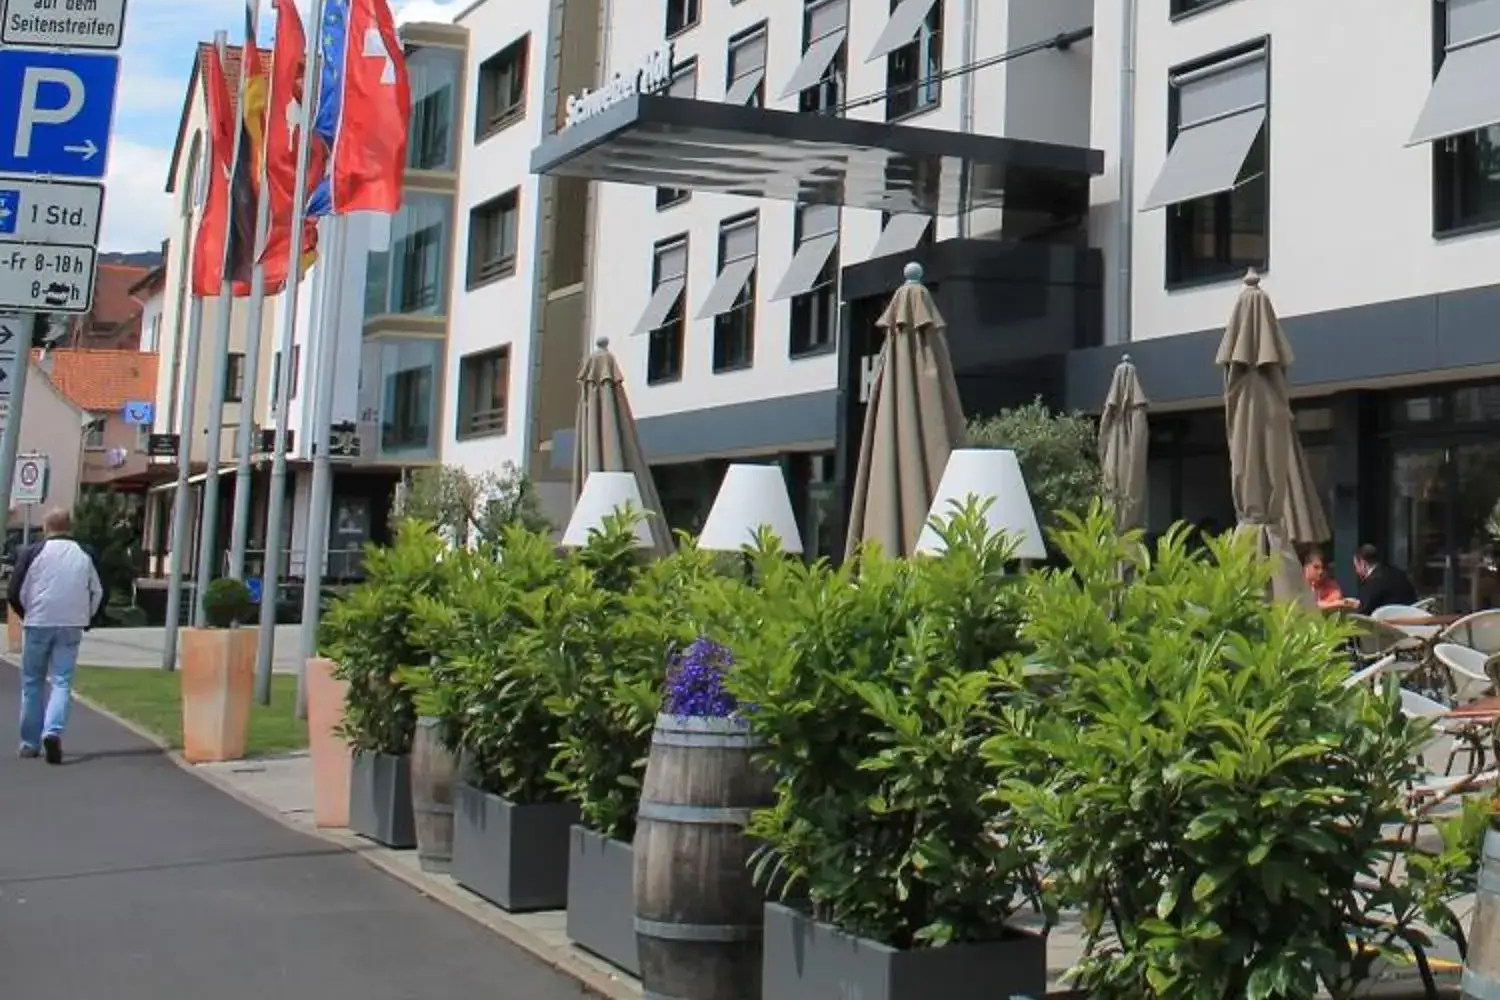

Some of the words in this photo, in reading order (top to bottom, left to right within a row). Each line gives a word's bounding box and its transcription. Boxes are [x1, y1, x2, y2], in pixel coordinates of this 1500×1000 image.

[11, 13, 115, 37] Seitenstreifen
[13, 66, 85, 158] P
[46, 205, 87, 227] Std.
